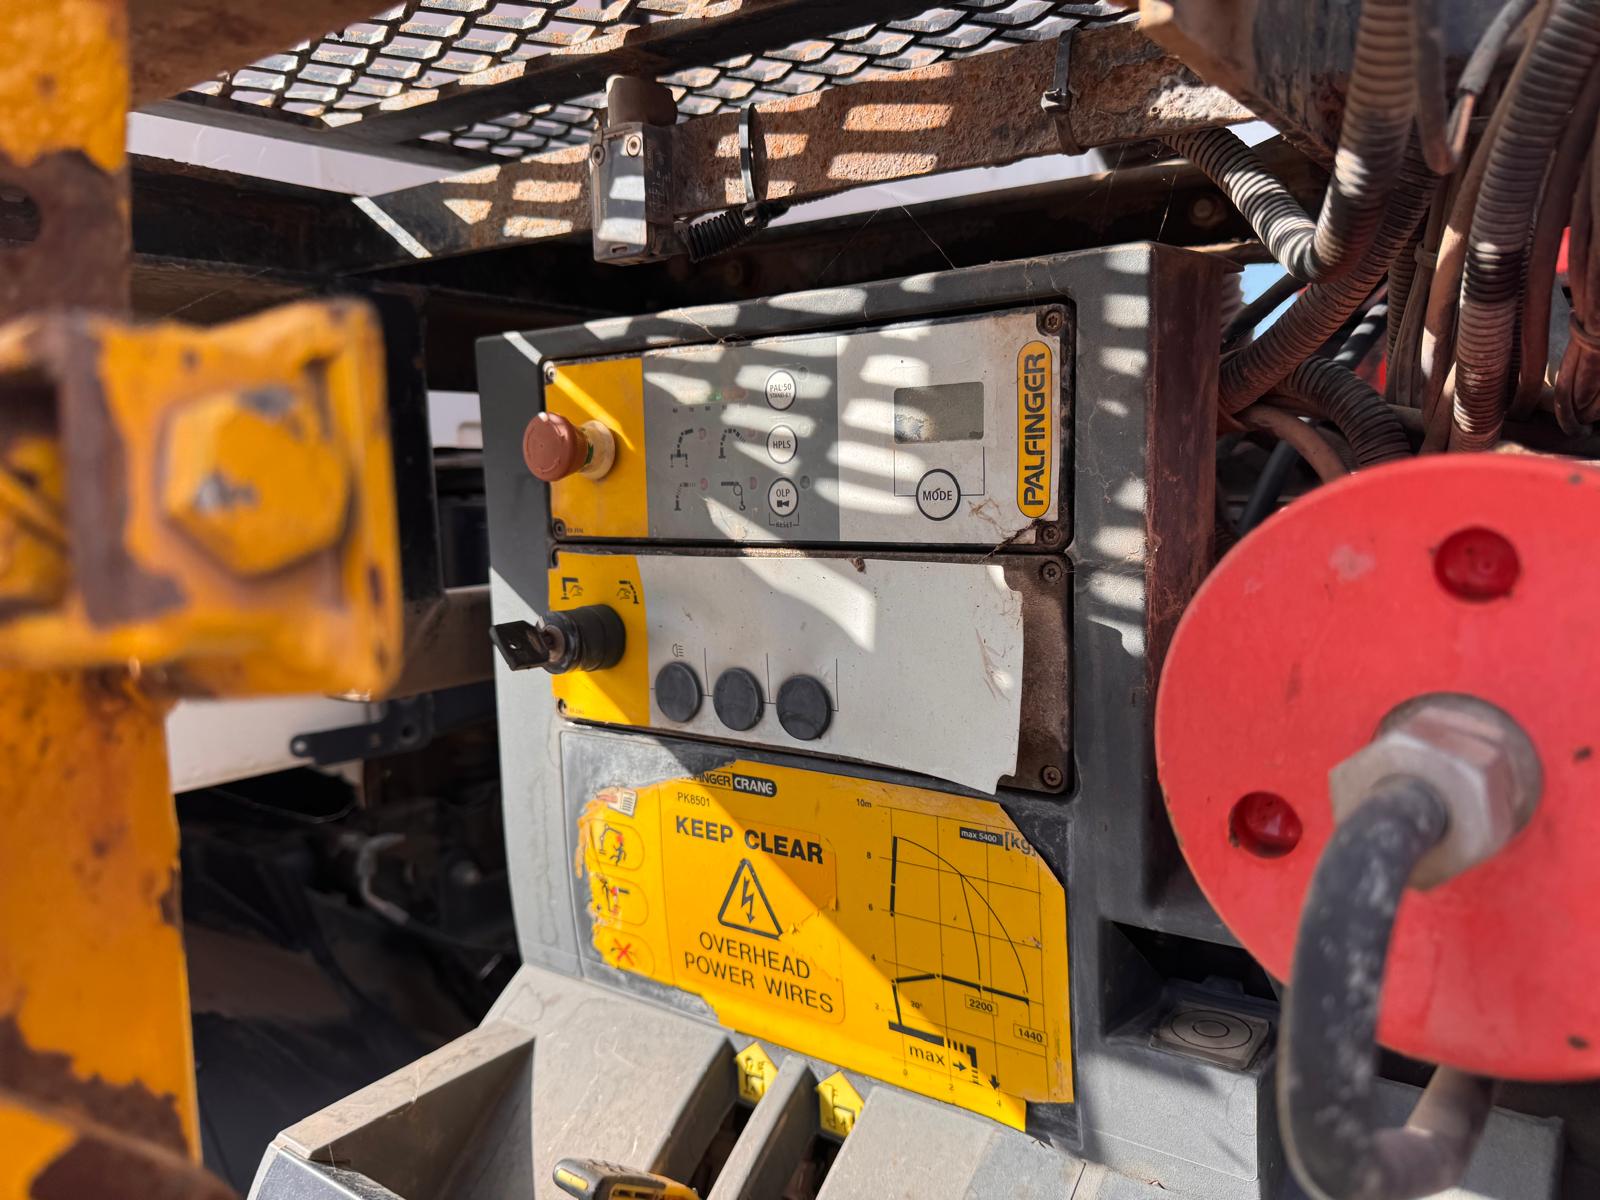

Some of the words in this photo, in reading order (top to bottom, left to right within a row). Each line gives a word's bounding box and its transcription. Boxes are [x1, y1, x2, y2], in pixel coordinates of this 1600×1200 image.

[1023, 352, 1046, 506] PALFINGER
[772, 439, 792, 450] HPLS
[775, 488, 791, 498] OLP
[922, 489, 953, 502] MODE
[734, 777, 774, 796] CRANE
[856, 798, 872, 809] 10m
[675, 815, 734, 844] KEEP
[744, 829, 824, 865] CLEAR
[961, 830, 977, 839] max
[979, 832, 998, 843] 5400
[699, 930, 811, 980] OVERHEAD
[684, 951, 756, 990] POWER
[764, 975, 834, 1015] WIRES
[969, 998, 993, 1013] 2200
[1017, 1027, 1043, 1043] 1440
[909, 1044, 946, 1067] max
